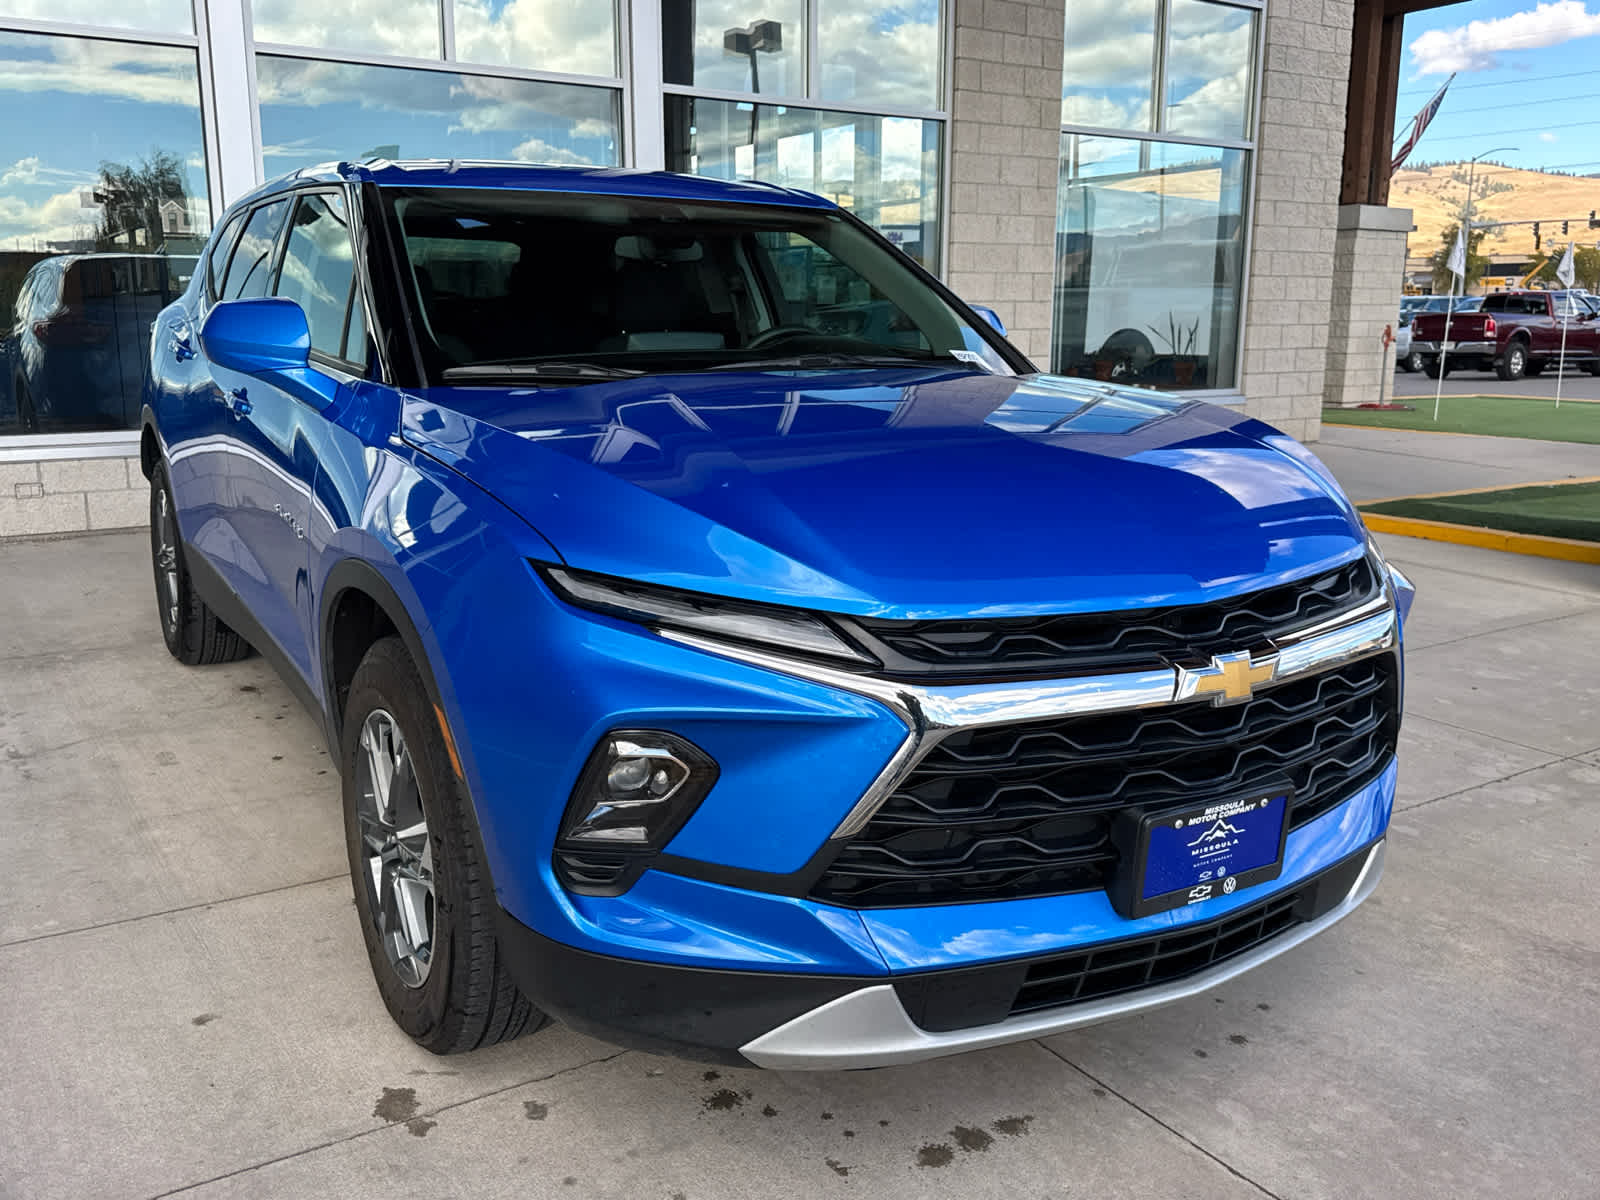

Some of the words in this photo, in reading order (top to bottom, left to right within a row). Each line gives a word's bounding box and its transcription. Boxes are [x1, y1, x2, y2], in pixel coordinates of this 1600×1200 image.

[1188, 813, 1218, 826] MOTOR
[1218, 802, 1257, 818] COMPANY
[1204, 799, 1245, 815] MISSOULA
[1191, 839, 1239, 856] MISSOULA
